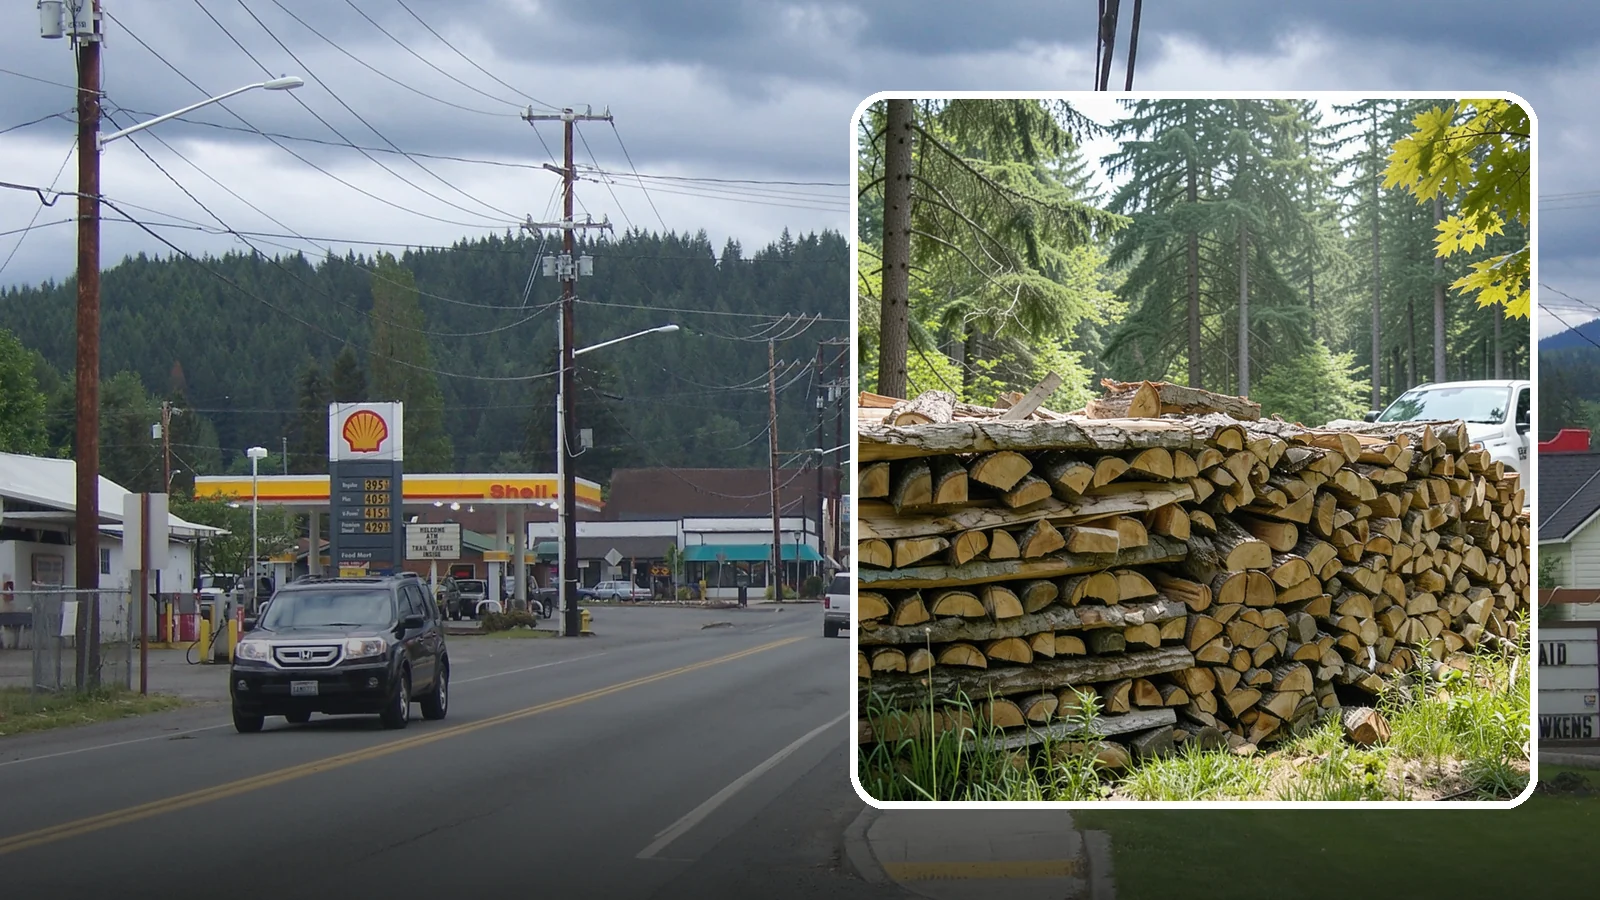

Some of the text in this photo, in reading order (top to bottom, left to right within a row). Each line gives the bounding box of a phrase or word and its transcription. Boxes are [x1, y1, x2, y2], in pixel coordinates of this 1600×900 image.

[365, 480, 383, 490] 395
[490, 484, 547, 499] Shell
[365, 494, 383, 504] 405
[365, 508, 383, 518] 415
[365, 522, 383, 532] 429
